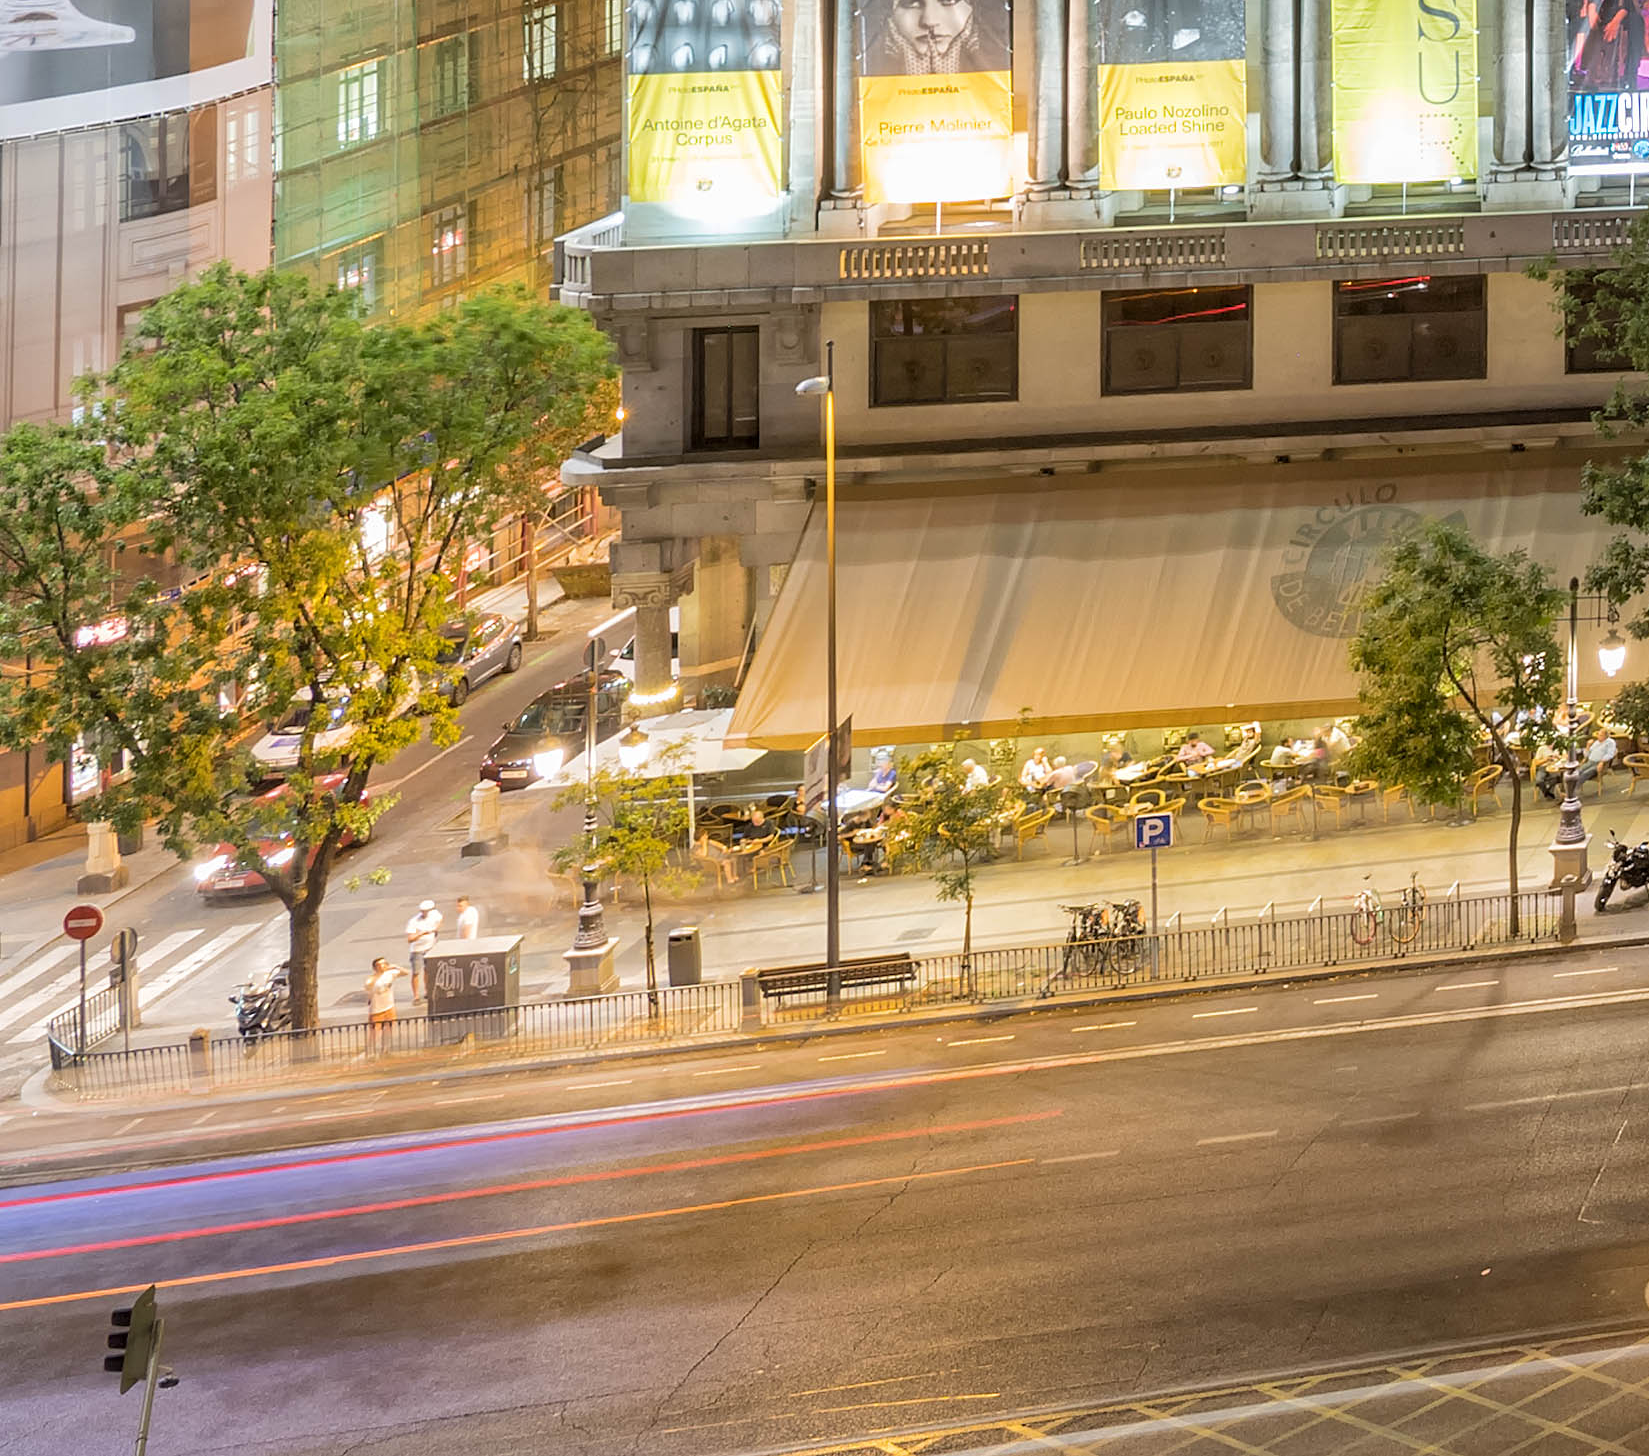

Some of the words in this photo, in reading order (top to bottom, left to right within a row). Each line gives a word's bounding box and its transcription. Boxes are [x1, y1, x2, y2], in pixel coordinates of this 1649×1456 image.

[1115, 106, 1158, 120] Paulo
[1163, 104, 1230, 118] Nozolino
[642, 117, 704, 131] Antoine
[708, 115, 768, 133] d'Agata
[879, 121, 925, 135] Pierre
[930, 118, 992, 133] Molinier
[1120, 121, 1178, 136] Loaded
[1182, 119, 1225, 134] Shine
[676, 133, 733, 147] Corpus
[1285, 483, 1398, 564] CIRCULO
[1279, 577, 1310, 613] DE
[1142, 818, 1164, 845] P
